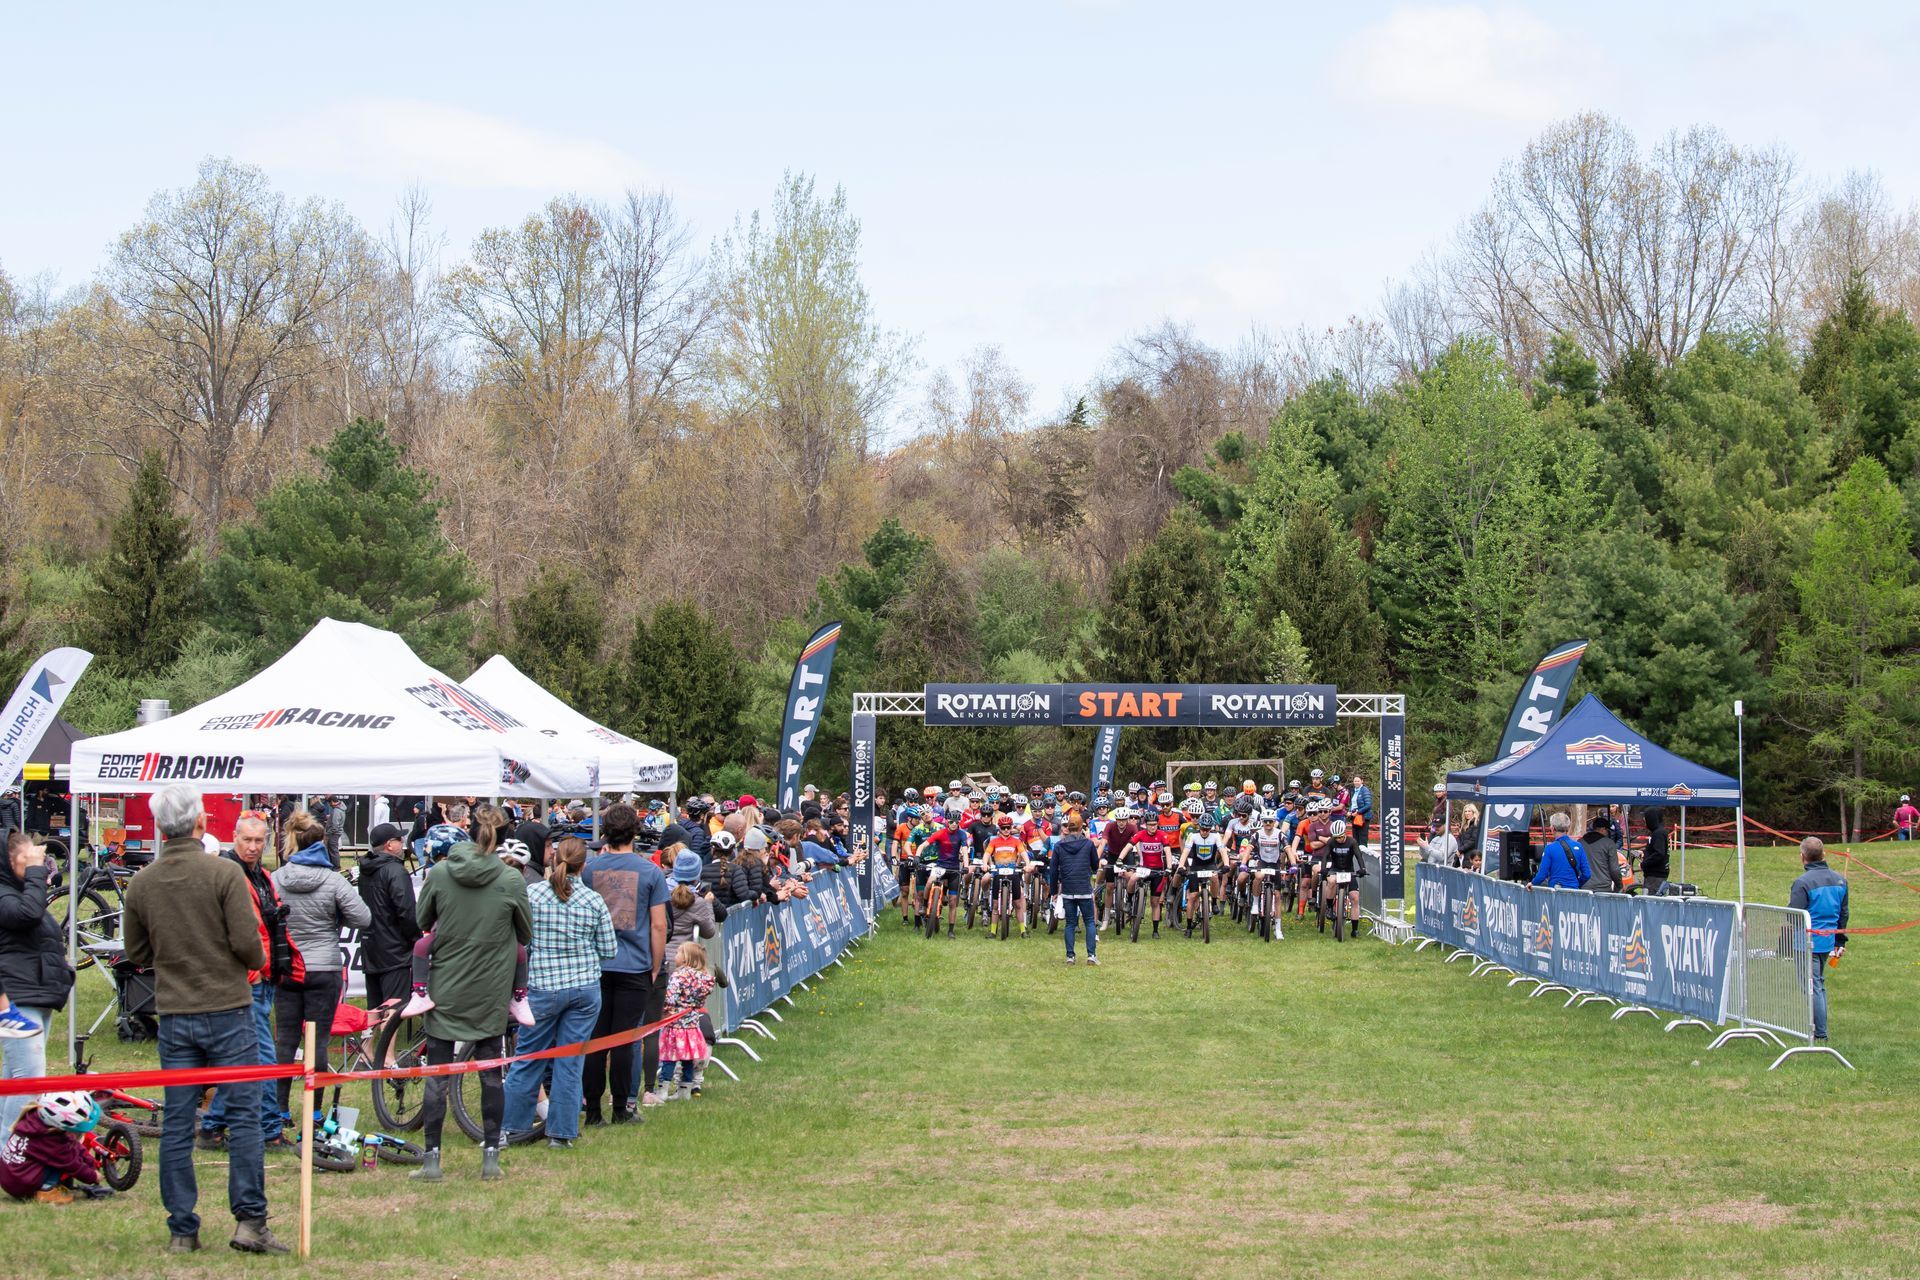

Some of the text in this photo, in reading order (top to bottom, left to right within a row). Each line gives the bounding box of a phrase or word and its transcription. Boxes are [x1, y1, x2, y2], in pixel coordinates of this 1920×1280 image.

[937, 691, 1050, 717] ROTATION
[1079, 691, 1183, 717] START
[1212, 691, 1325, 718] ROTATION
[0, 696, 41, 755] CHURCH
[19, 704, 49, 751] COMPANY
[199, 721, 259, 731] EDGE
[206, 707, 396, 729] COMP RACING
[783, 664, 825, 810] START
[101, 754, 245, 780] COMP RACING
[1099, 727, 1115, 784] ED ZONE
[97, 766, 142, 779] EDGE
[854, 740, 870, 808] ROTATION
[1385, 807, 1402, 875] ROTATION
